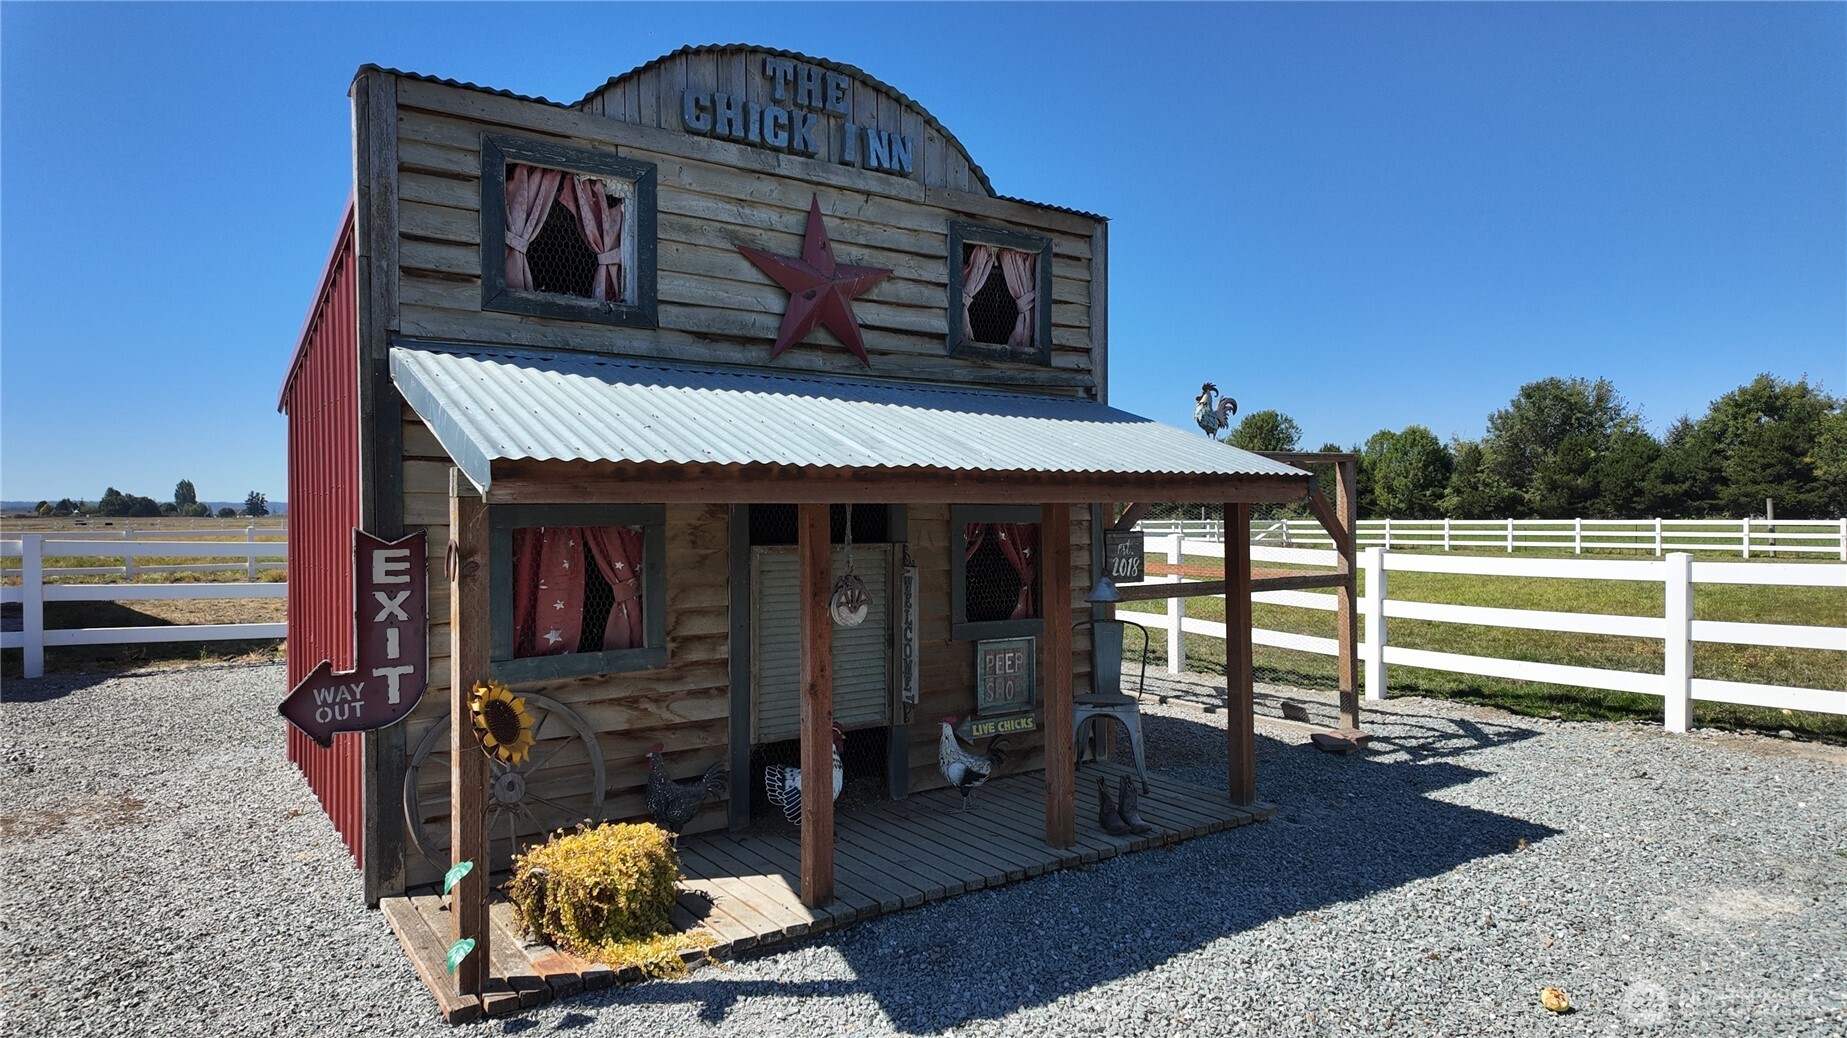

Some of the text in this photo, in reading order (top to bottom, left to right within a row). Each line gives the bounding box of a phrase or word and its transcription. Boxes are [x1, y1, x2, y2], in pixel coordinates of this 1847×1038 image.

[762, 57, 848, 117] THE
[682, 88, 914, 176] CHICK INN
[1112, 557, 1140, 577] 2018
[372, 548, 414, 704] EXIT
[986, 652, 1023, 674] PEEP
[313, 682, 365, 706] WAY
[315, 701, 365, 723] OUT
[972, 718, 1034, 736] LIVE CHICKS
